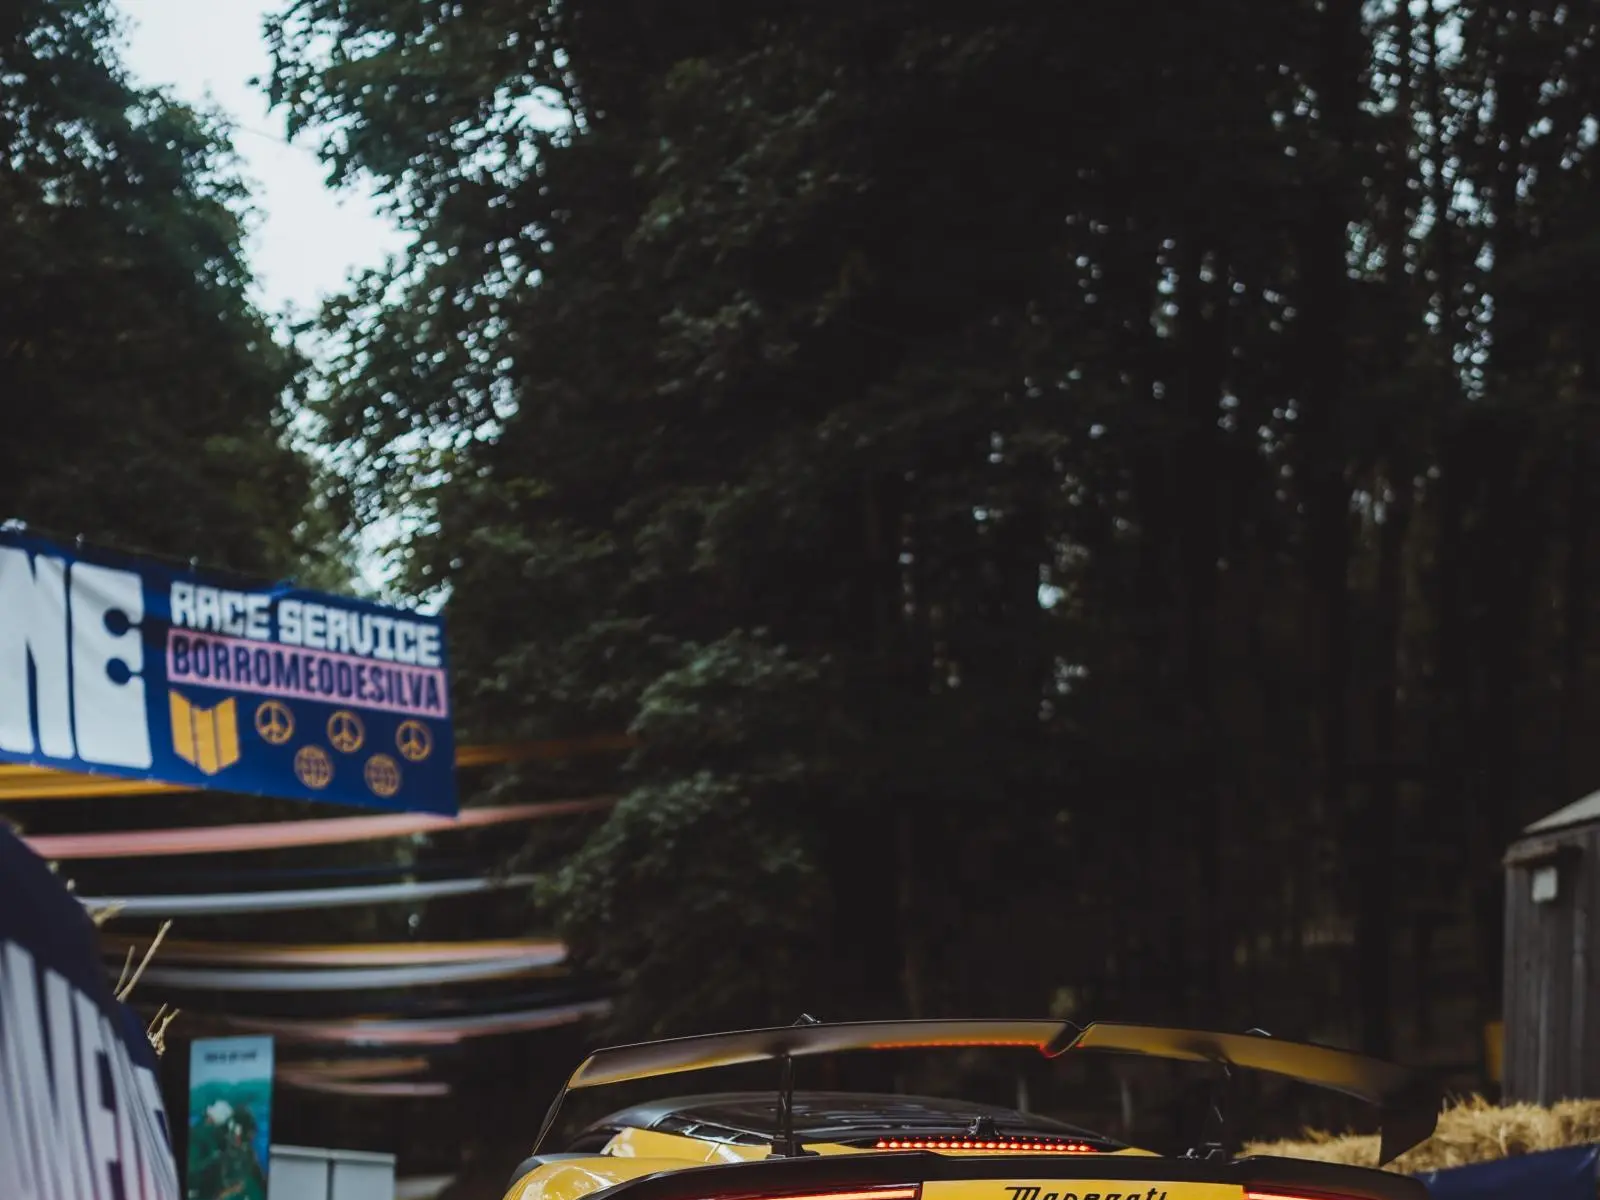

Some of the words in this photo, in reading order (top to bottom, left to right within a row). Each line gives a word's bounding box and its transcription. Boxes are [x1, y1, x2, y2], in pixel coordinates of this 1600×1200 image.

[169, 581, 271, 641] RACE
[278, 600, 441, 667] SERVICE
[172, 634, 442, 713] BORROMEODESILVA
